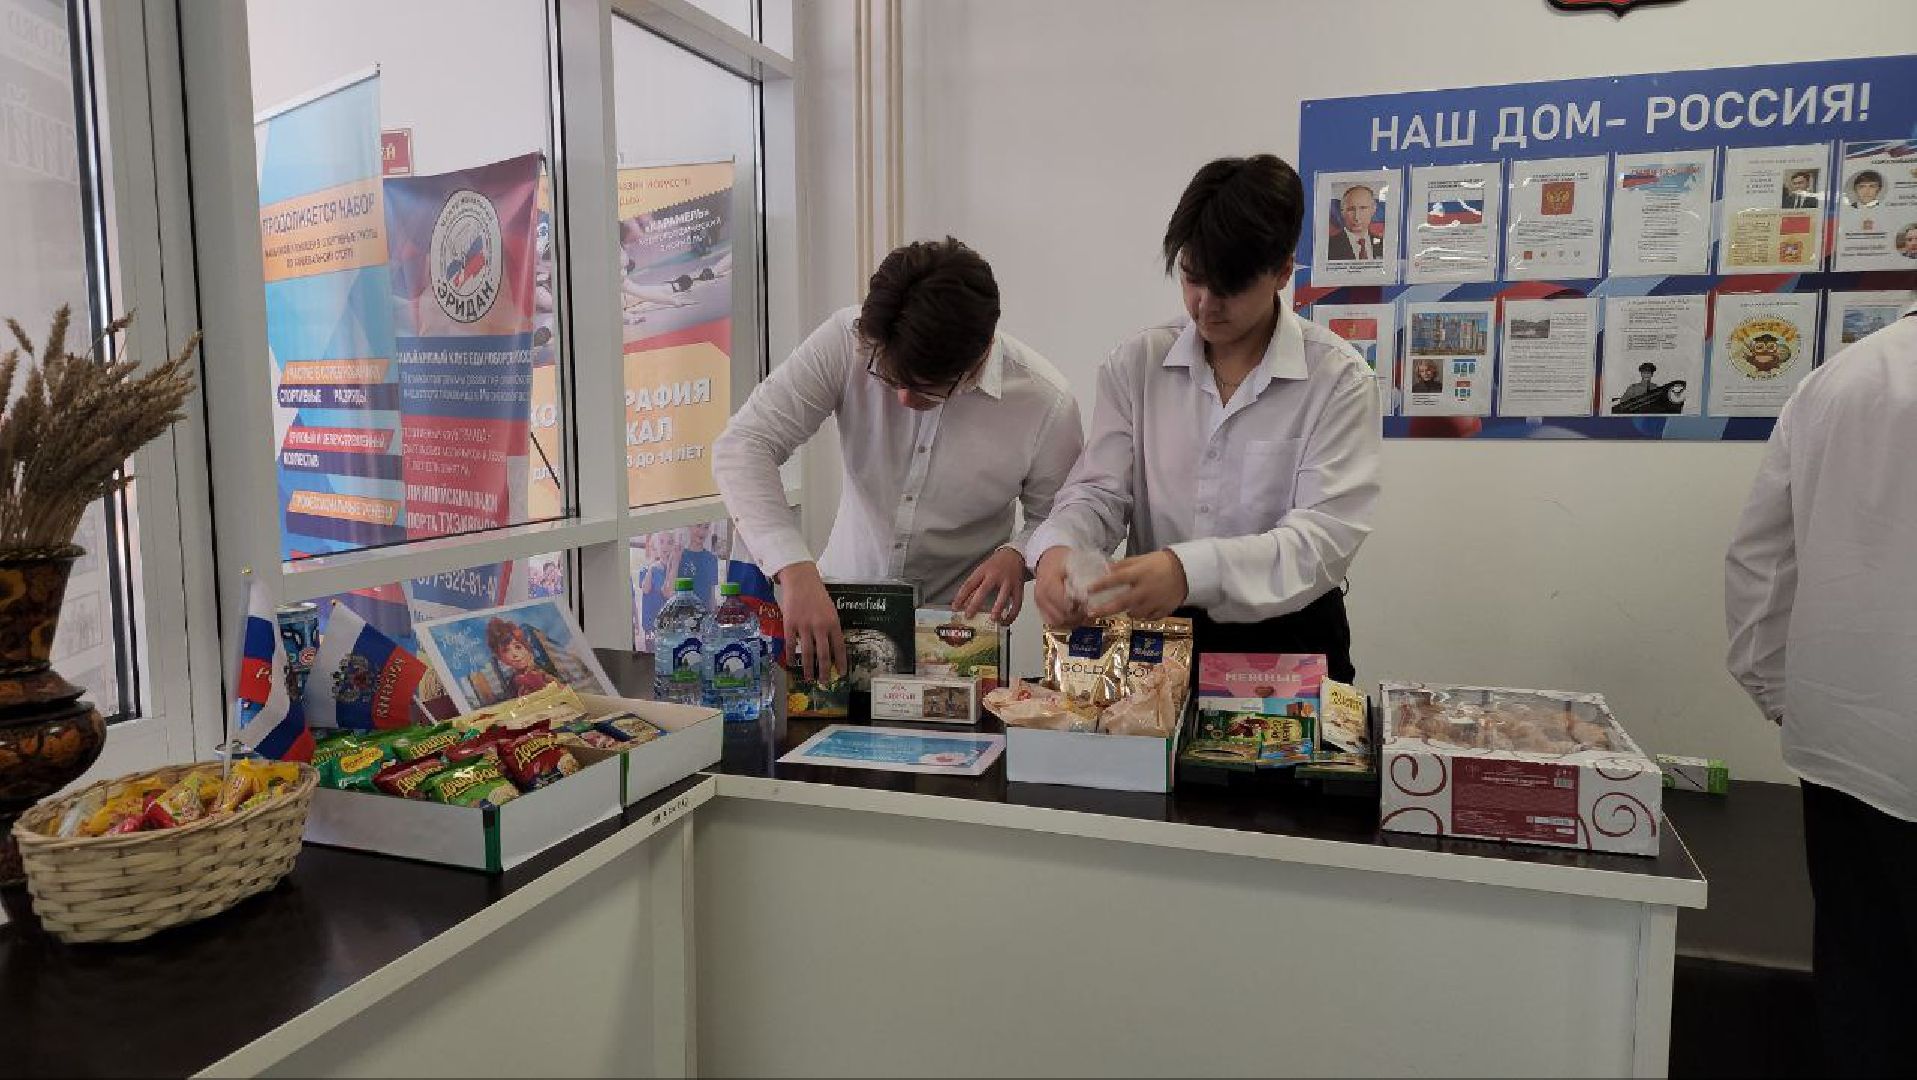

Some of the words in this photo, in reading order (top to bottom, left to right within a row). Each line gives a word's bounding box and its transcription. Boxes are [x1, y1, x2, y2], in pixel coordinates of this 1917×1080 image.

[1370, 109, 1476, 152] НАШ
[1646, 82, 1872, 134] РОССИЯ!
[338, 192, 375, 220] НАБОР
[437, 281, 495, 321] ЭРИДАН
[280, 388, 322, 403] СПОРТИВНЫЕ
[407, 512, 437, 532] ПОРТА
[836, 596, 887, 613] Greenfield
[1060, 662, 1104, 675] GOLD
